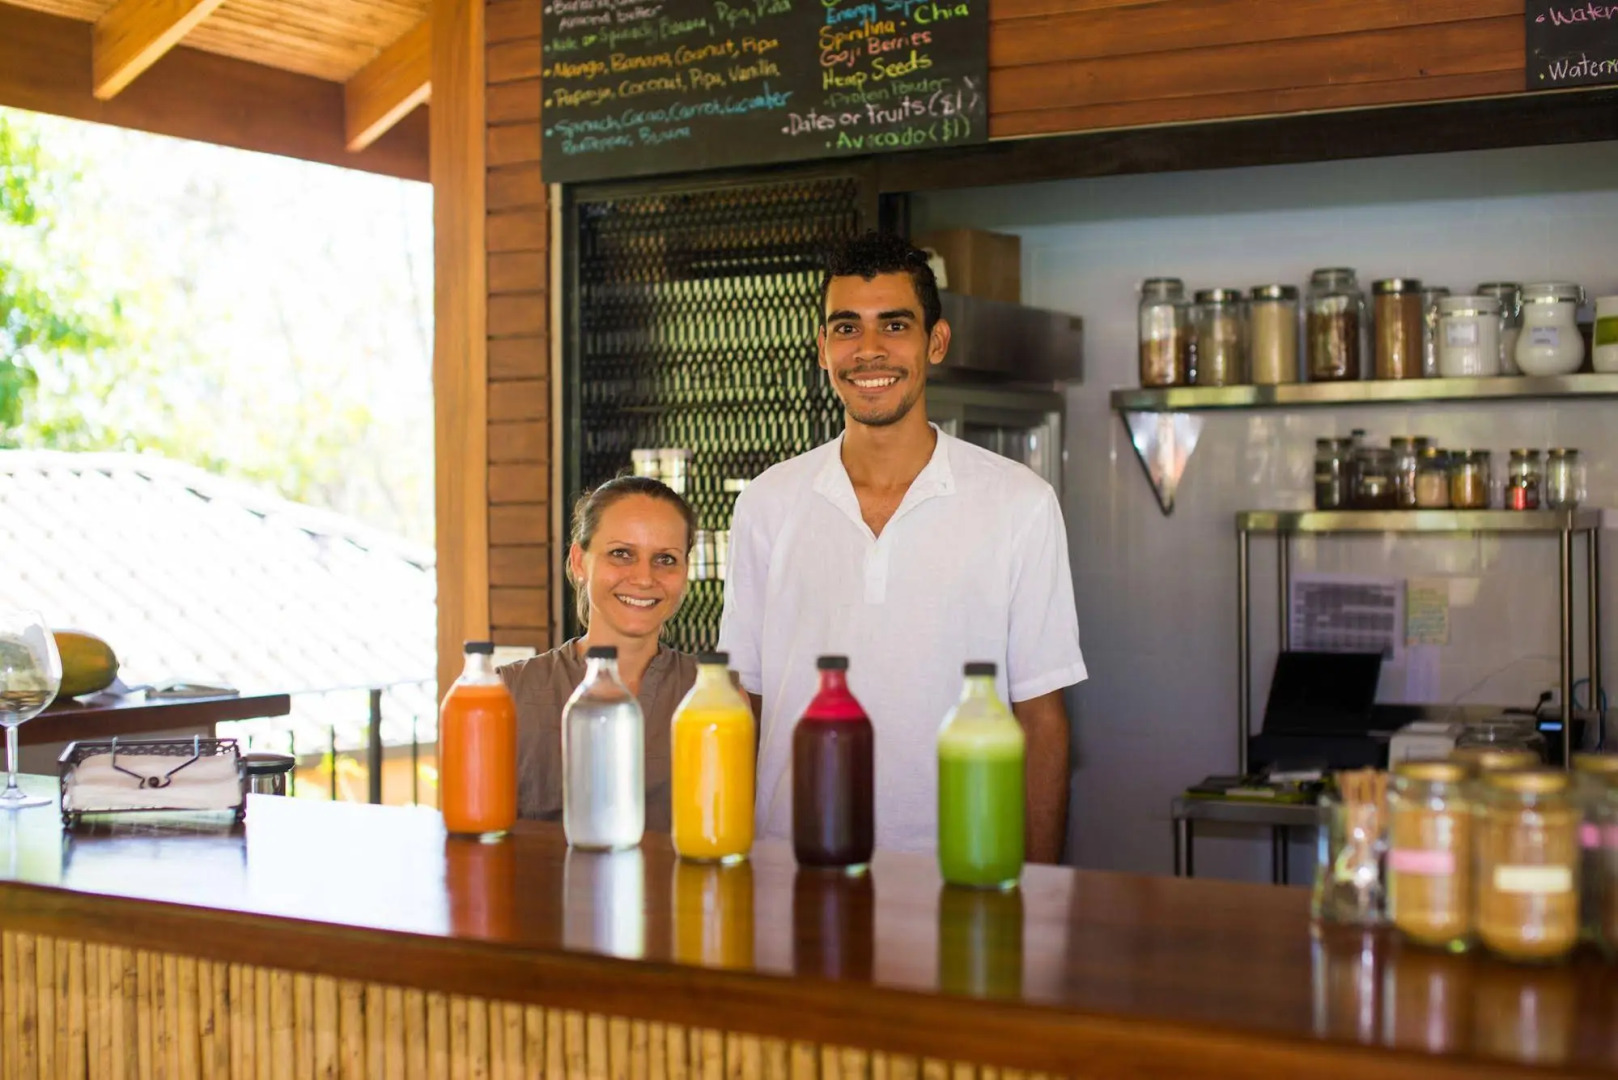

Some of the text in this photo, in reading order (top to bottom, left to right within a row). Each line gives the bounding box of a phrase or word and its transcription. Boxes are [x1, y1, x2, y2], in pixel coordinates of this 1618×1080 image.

[914, 3, 969, 24] Chia
[868, 30, 932, 55] Berries
[871, 50, 933, 81] Seeds
[788, 108, 836, 136] Dates
[839, 113, 861, 125] or
